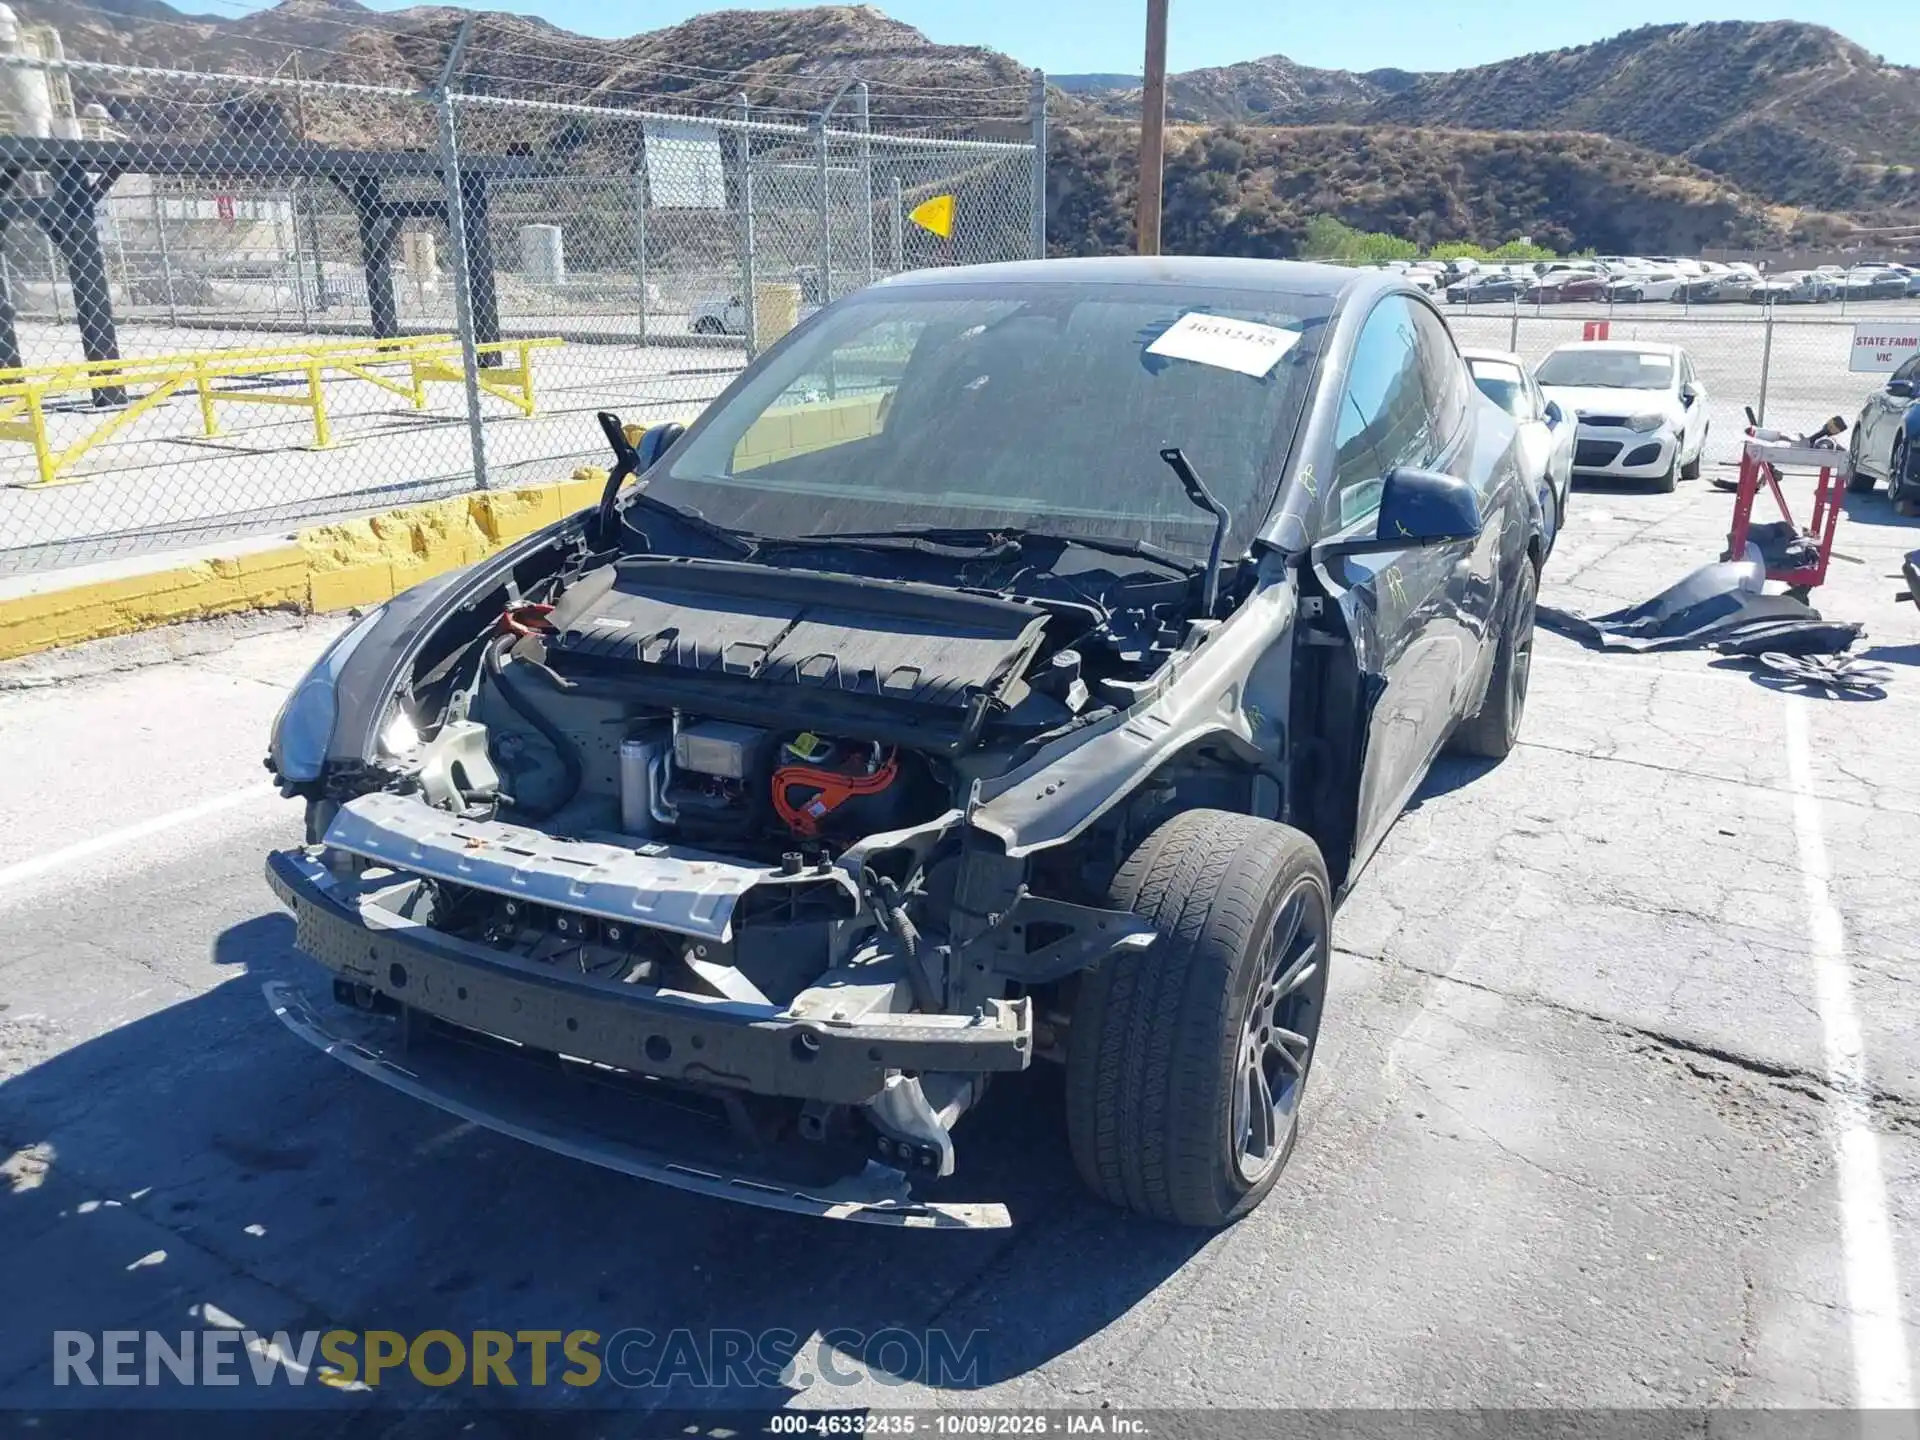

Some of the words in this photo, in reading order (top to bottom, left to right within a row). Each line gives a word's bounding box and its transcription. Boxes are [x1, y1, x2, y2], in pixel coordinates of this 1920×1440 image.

[1855, 336, 1886, 346] STATE
[1888, 336, 1918, 346] FARM
[1876, 352, 1893, 362] VIC
